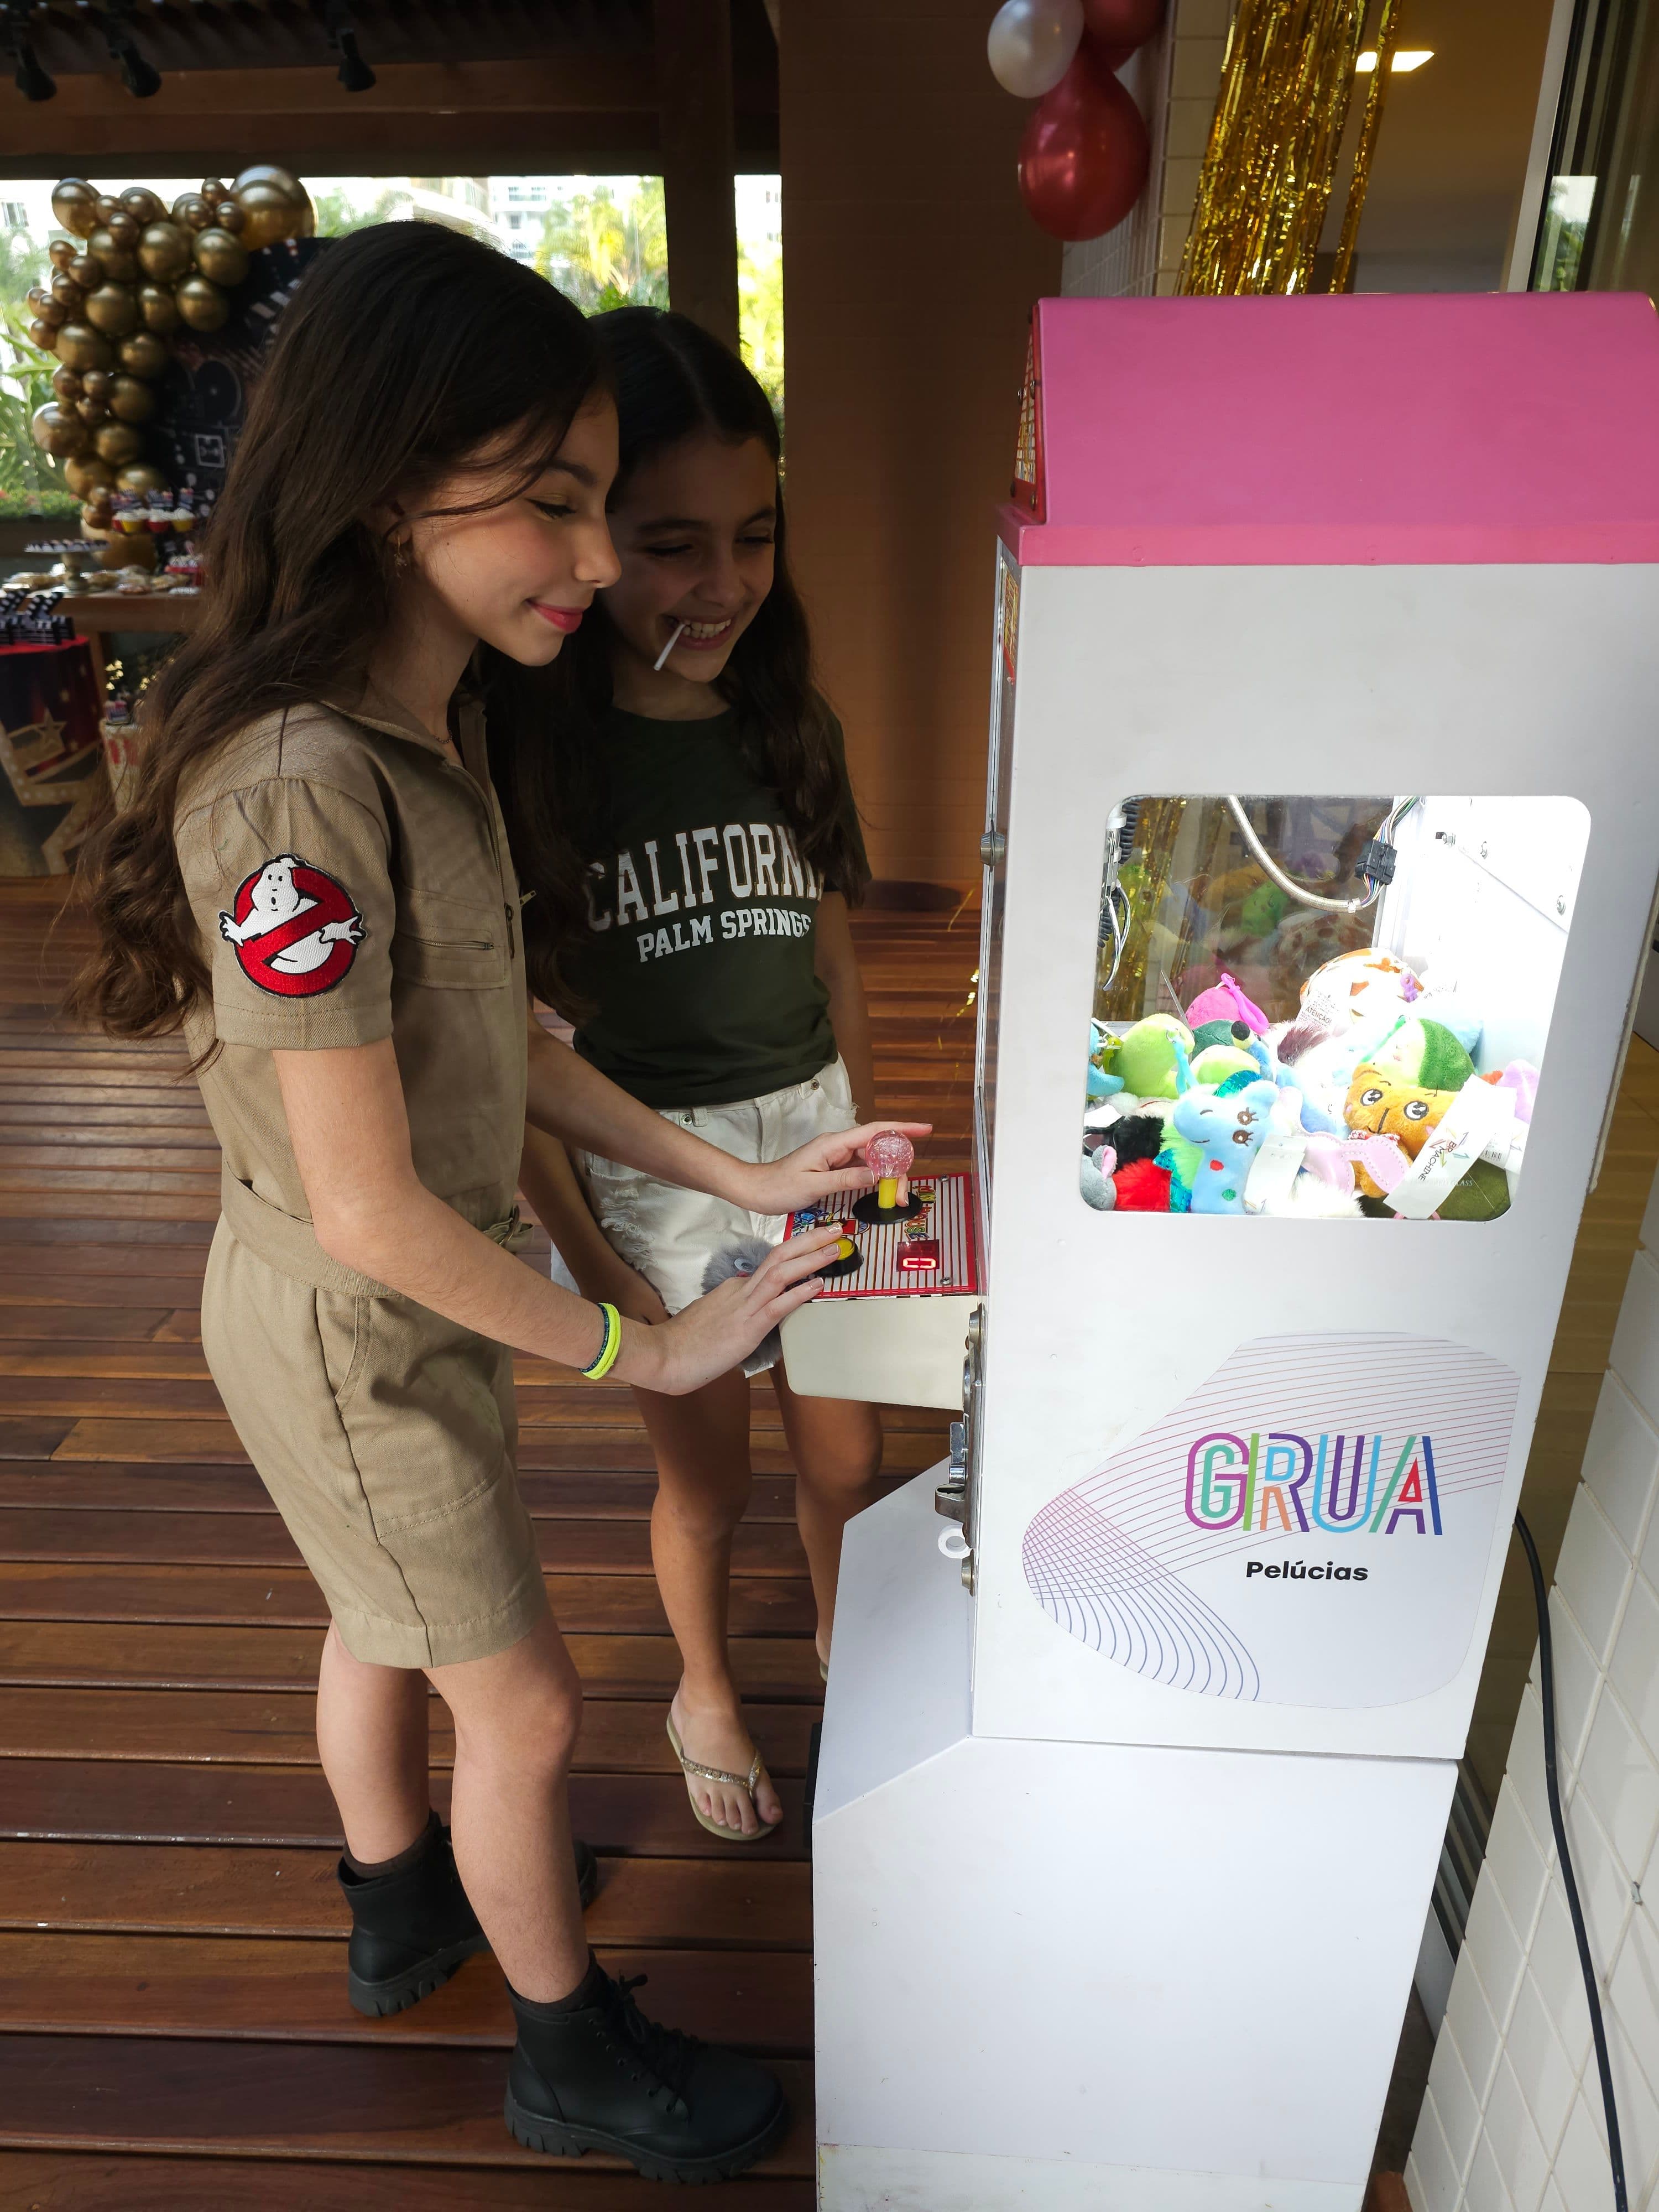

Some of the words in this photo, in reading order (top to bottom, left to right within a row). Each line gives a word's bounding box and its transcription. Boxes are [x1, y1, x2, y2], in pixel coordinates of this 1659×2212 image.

[582, 823, 824, 932] CALIFORNI
[637, 915, 713, 963] PALM
[721, 908, 812, 940] SPRINGS
[1418, 1145, 1445, 1181] MACHINE
[1444, 1141, 1457, 1153] BR
[1185, 1432, 1443, 1536] GRUA
[1246, 1560, 1369, 1582] Pelúcias
